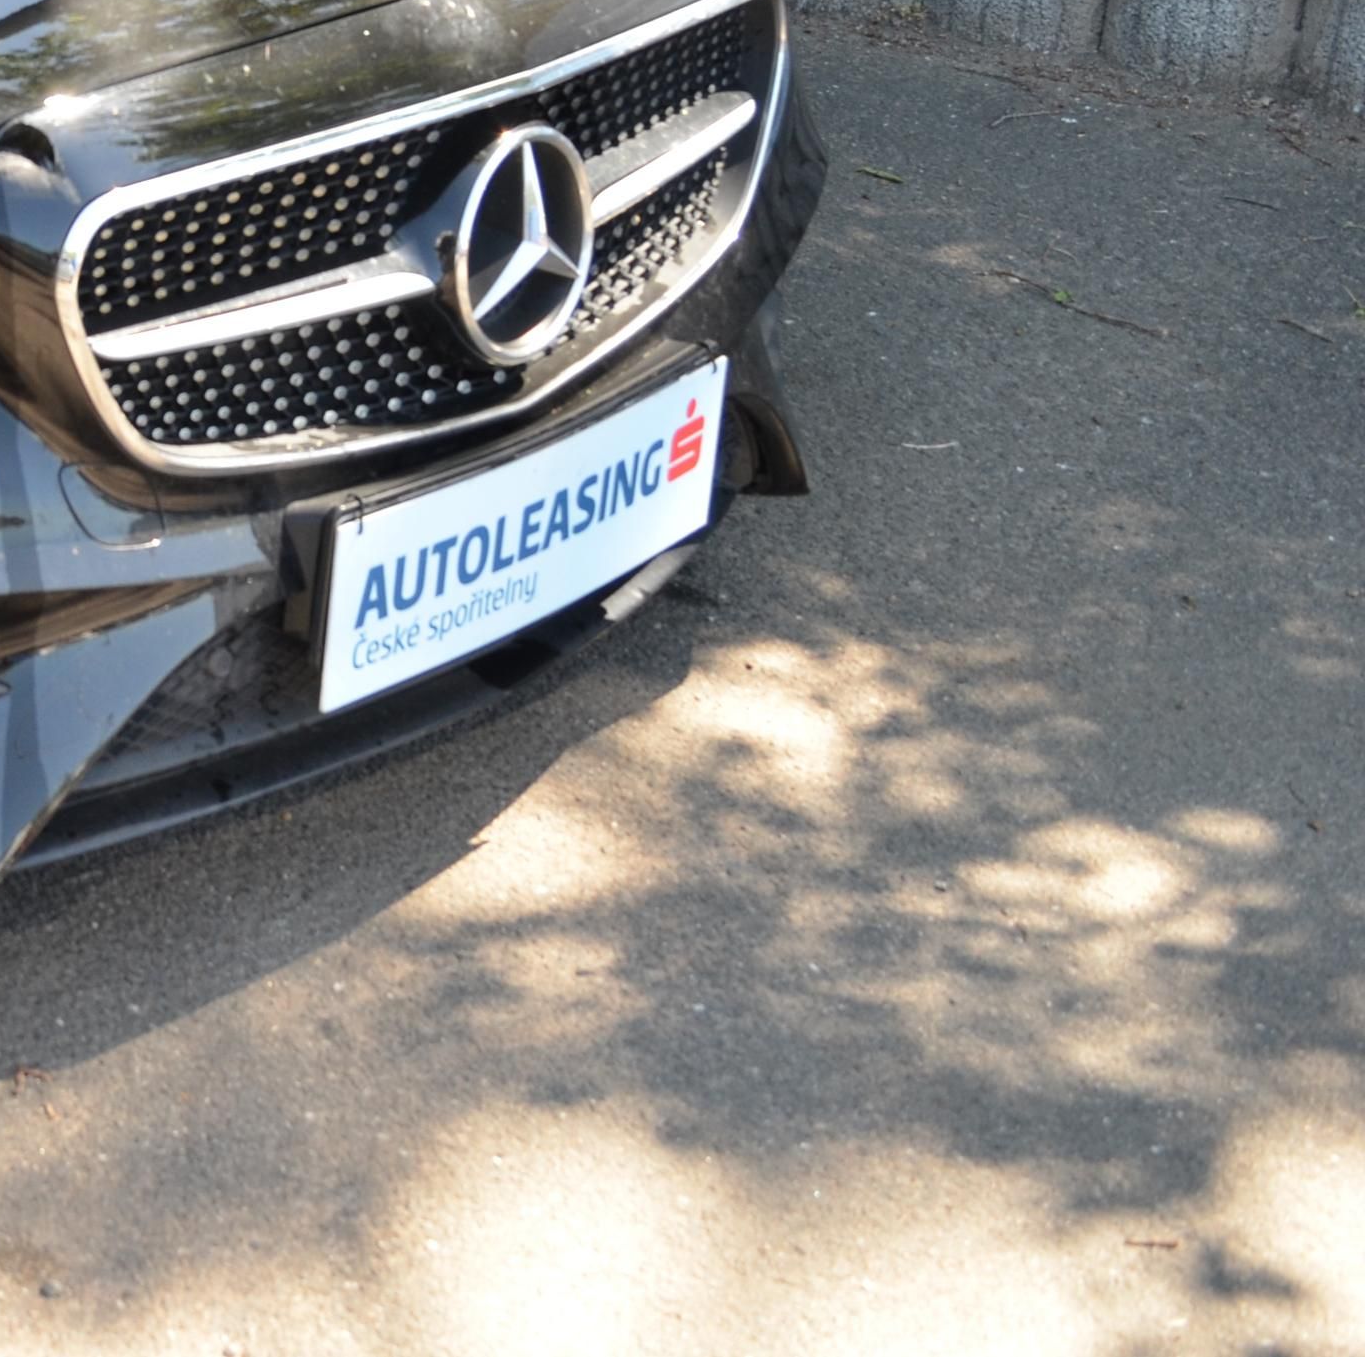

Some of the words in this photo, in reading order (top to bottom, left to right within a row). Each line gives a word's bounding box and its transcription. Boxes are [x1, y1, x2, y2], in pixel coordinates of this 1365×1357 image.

[355, 439, 664, 629] AUTOLEASING
[352, 622, 420, 669] České
[427, 572, 538, 641] spořitelny
